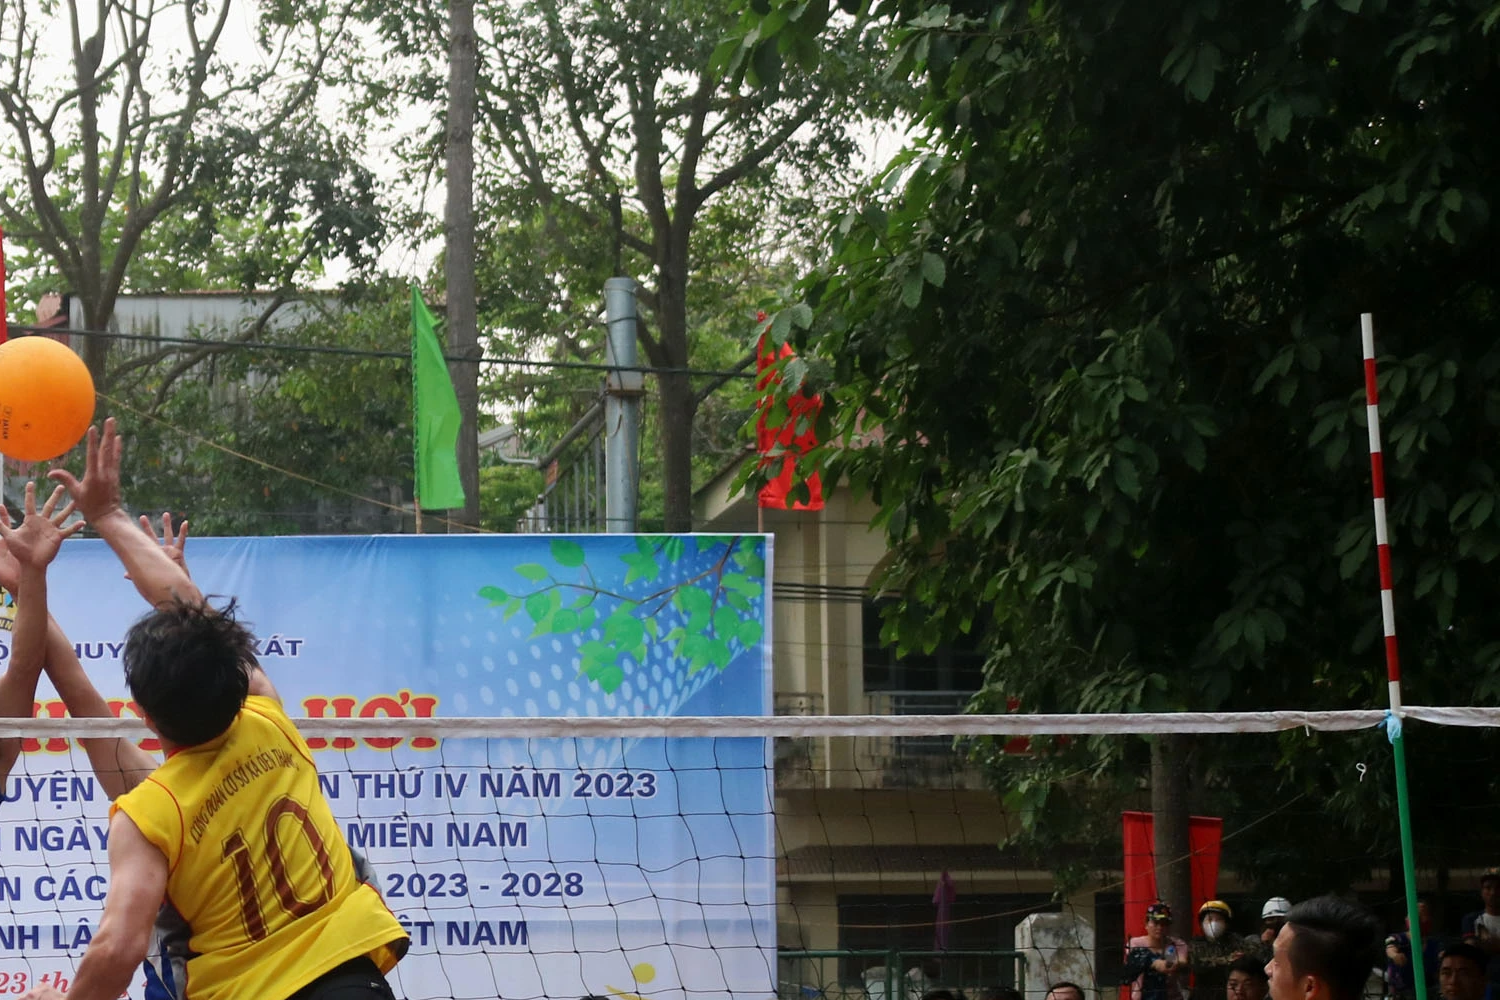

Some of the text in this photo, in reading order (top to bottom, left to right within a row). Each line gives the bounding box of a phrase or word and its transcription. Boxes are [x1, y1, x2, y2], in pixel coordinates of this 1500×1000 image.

[6, 771, 93, 809] UYỆN
[352, 766, 423, 798] THỨ
[435, 774, 468, 798] IV
[480, 766, 561, 798] NĂM
[573, 773, 656, 798] 2023
[14, 820, 109, 851] NGÀY
[347, 812, 433, 848] MIỀN
[446, 822, 528, 848] NAM
[34, 869, 107, 901] CÁC
[386, 873, 468, 898] 2023
[501, 872, 584, 898] 2028
[221, 792, 336, 944] 10
[446, 920, 528, 946] NAM
